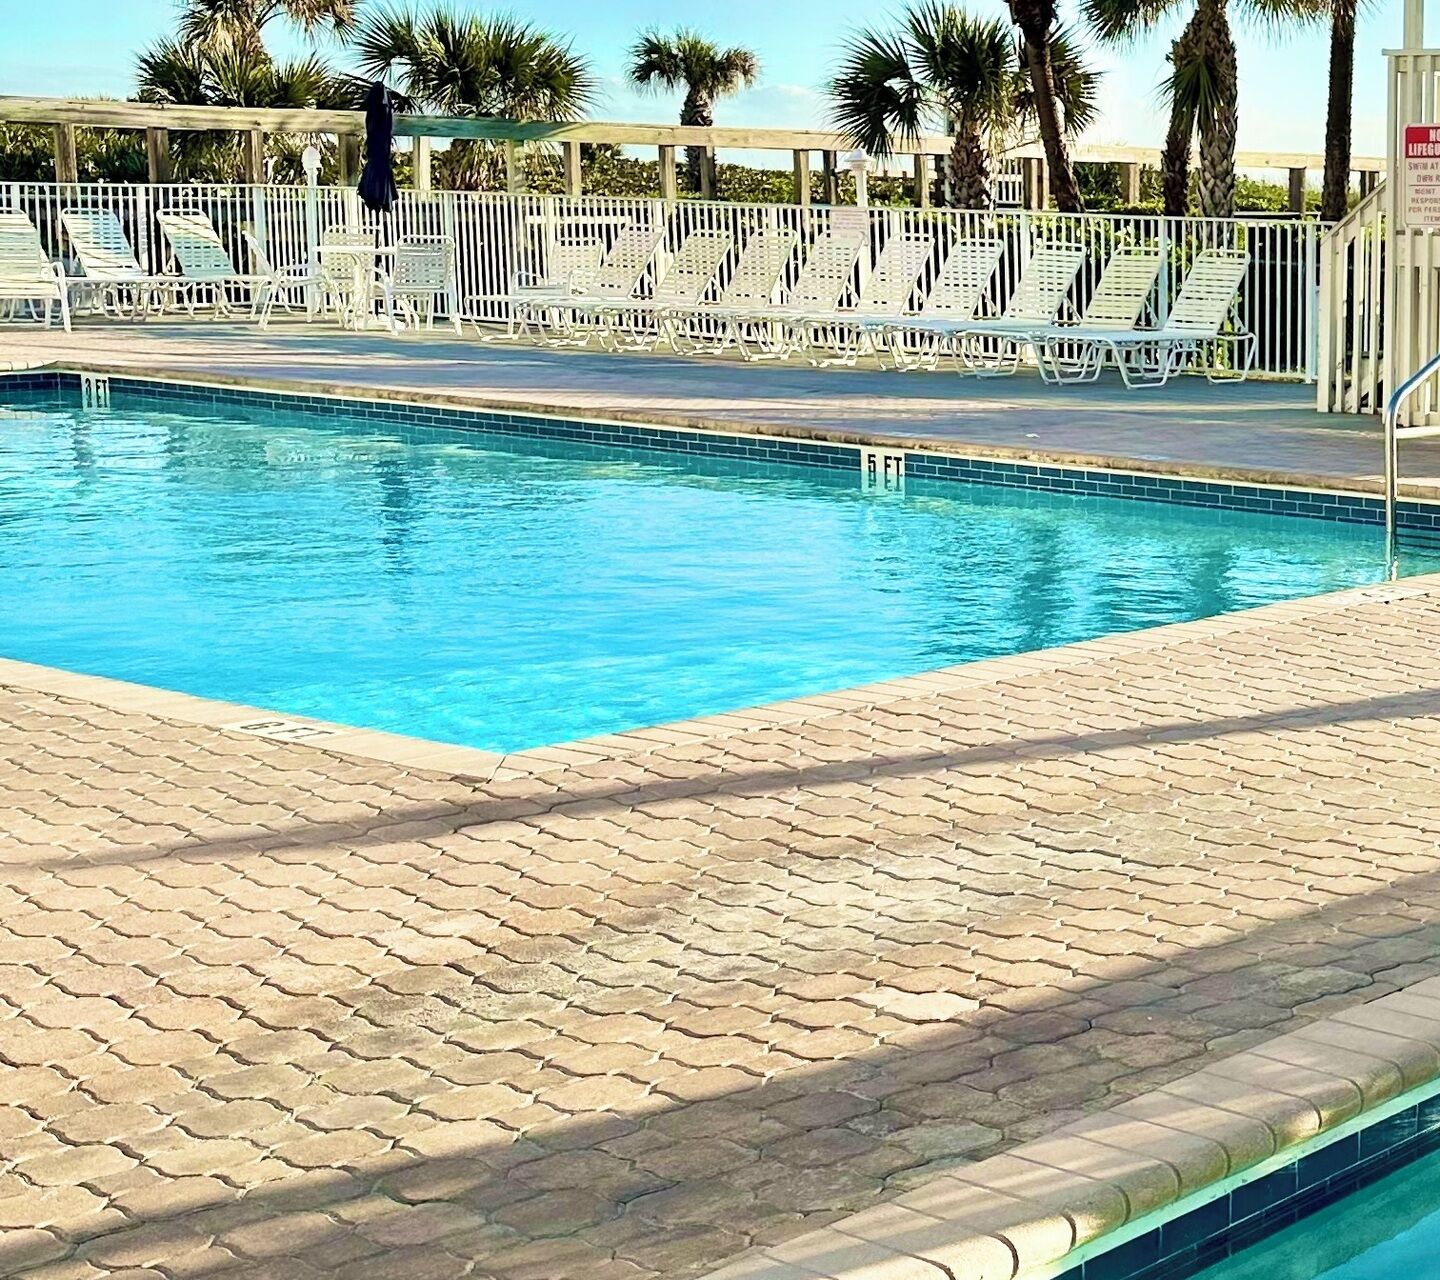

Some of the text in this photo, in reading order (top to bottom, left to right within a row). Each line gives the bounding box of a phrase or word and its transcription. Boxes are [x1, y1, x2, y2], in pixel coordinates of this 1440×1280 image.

[1408, 162, 1429, 171] SWIM
[1430, 162, 1439, 170] AT
[1416, 174, 1434, 183] OWN
[867, 453, 877, 473] 5
